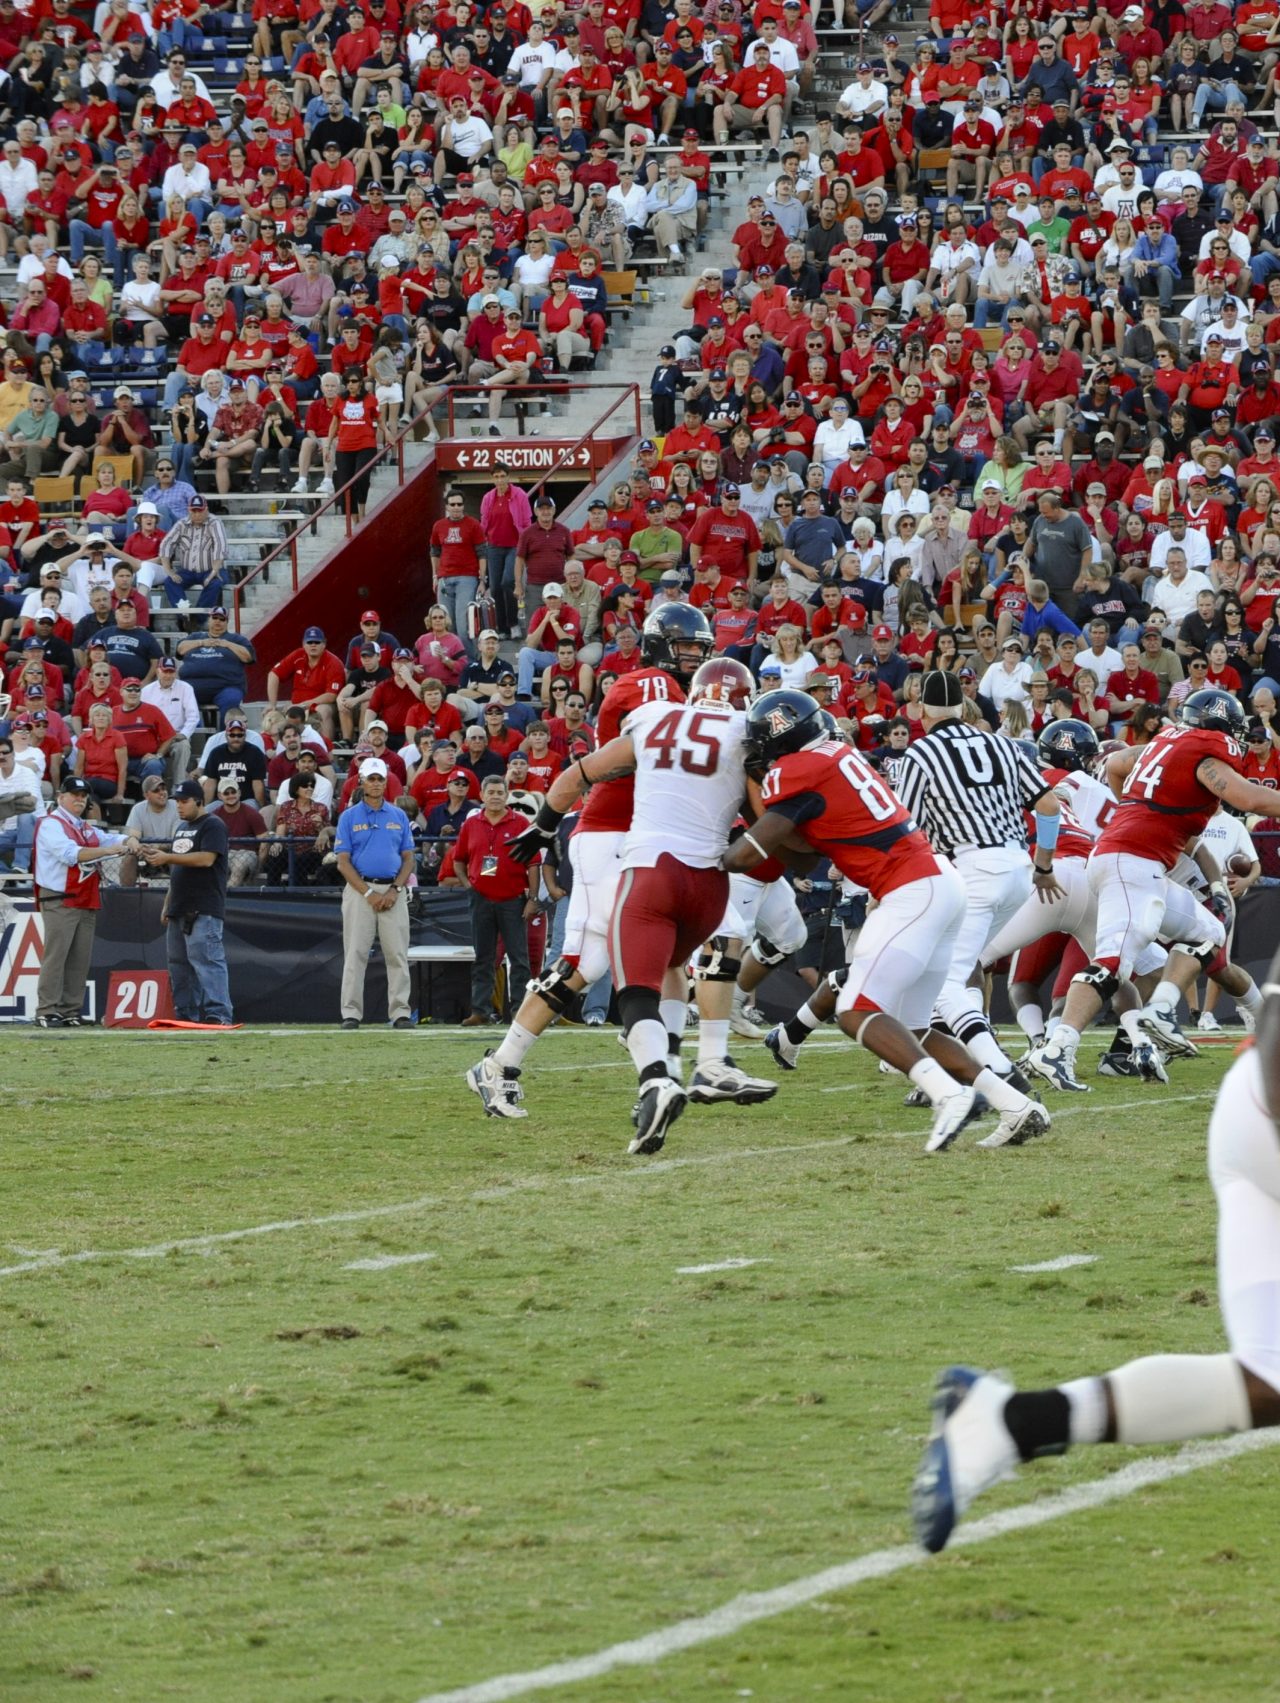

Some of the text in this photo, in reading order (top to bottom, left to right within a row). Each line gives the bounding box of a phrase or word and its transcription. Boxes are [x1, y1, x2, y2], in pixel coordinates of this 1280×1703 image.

[1073, 53, 1081, 72] 1
[1118, 200, 1134, 219] A
[863, 232, 888, 242] RIZONA
[659, 368, 668, 382] 7
[473, 449, 489, 467] 22
[495, 448, 553, 467] SECTION
[444, 527, 463, 544] A
[637, 676, 668, 703] 78
[1209, 697, 1229, 720] A
[766, 707, 795, 738] A
[644, 709, 730, 777] 45
[1056, 729, 1076, 752] A
[951, 736, 991, 784] U
[1122, 742, 1172, 799] 64
[838, 748, 897, 822] 8
[114, 980, 159, 1019] 20
